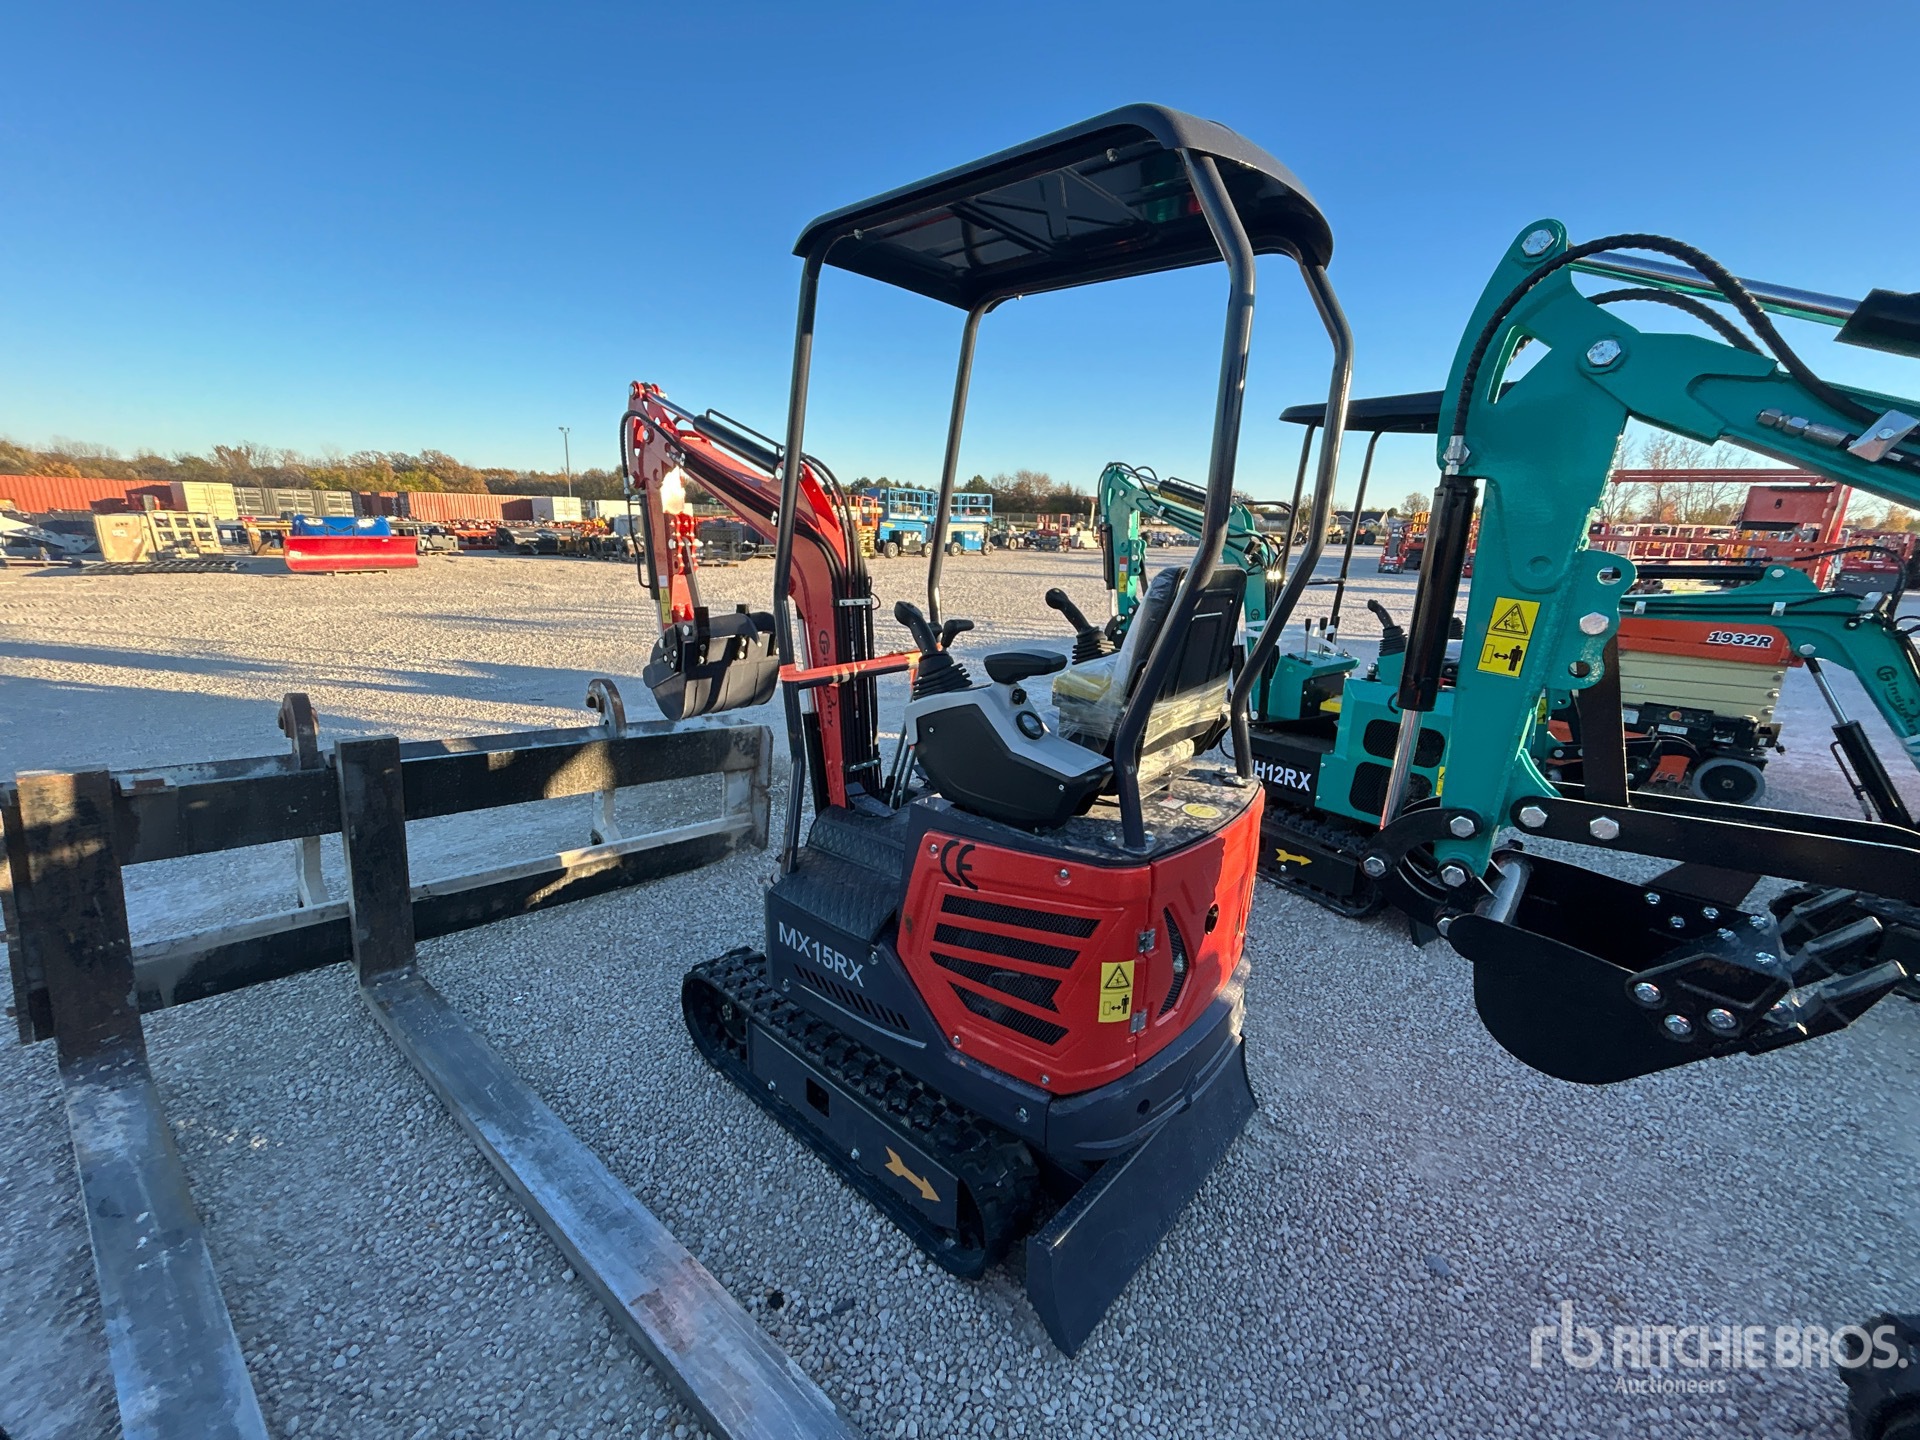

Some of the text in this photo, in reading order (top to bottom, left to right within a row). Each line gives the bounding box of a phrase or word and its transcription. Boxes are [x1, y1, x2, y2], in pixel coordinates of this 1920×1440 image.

[1706, 630, 1774, 649] 1932R
[1251, 759, 1312, 792] H12RX
[941, 839, 979, 892] CE
[778, 921, 865, 989] MX15RX
